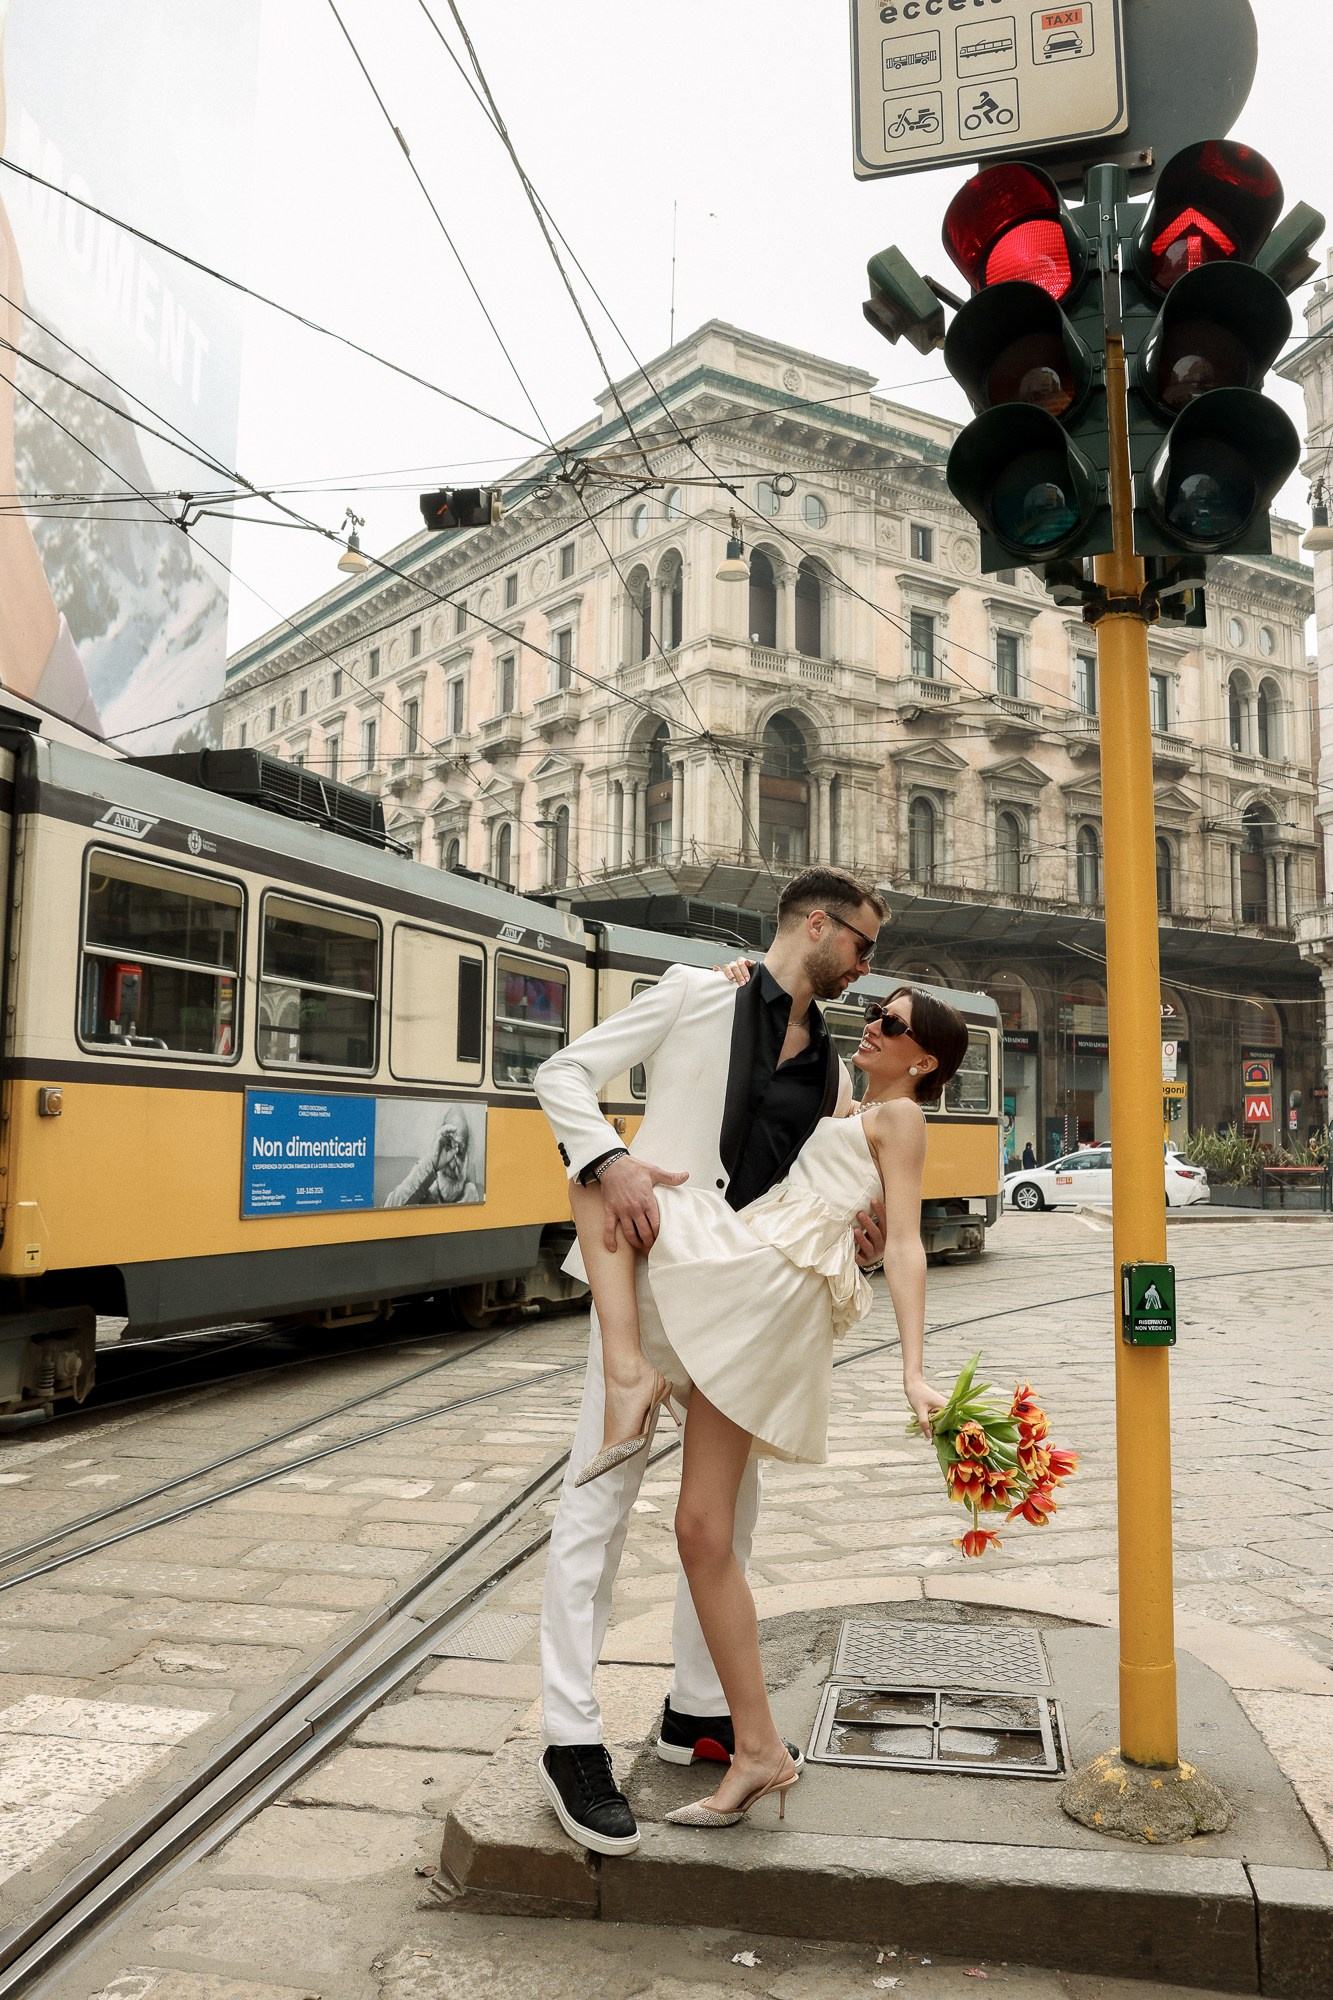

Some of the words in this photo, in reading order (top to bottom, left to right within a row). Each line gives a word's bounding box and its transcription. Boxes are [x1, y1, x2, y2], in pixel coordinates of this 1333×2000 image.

[880, 0, 1002, 24] ecce
[1046, 11, 1079, 26] TAXI
[20, 106, 209, 406] MOMENT
[113, 813, 140, 832] ATM
[1248, 1101, 1270, 1117] M
[253, 1136, 283, 1157] Non
[286, 1136, 367, 1157] dimenticarti
